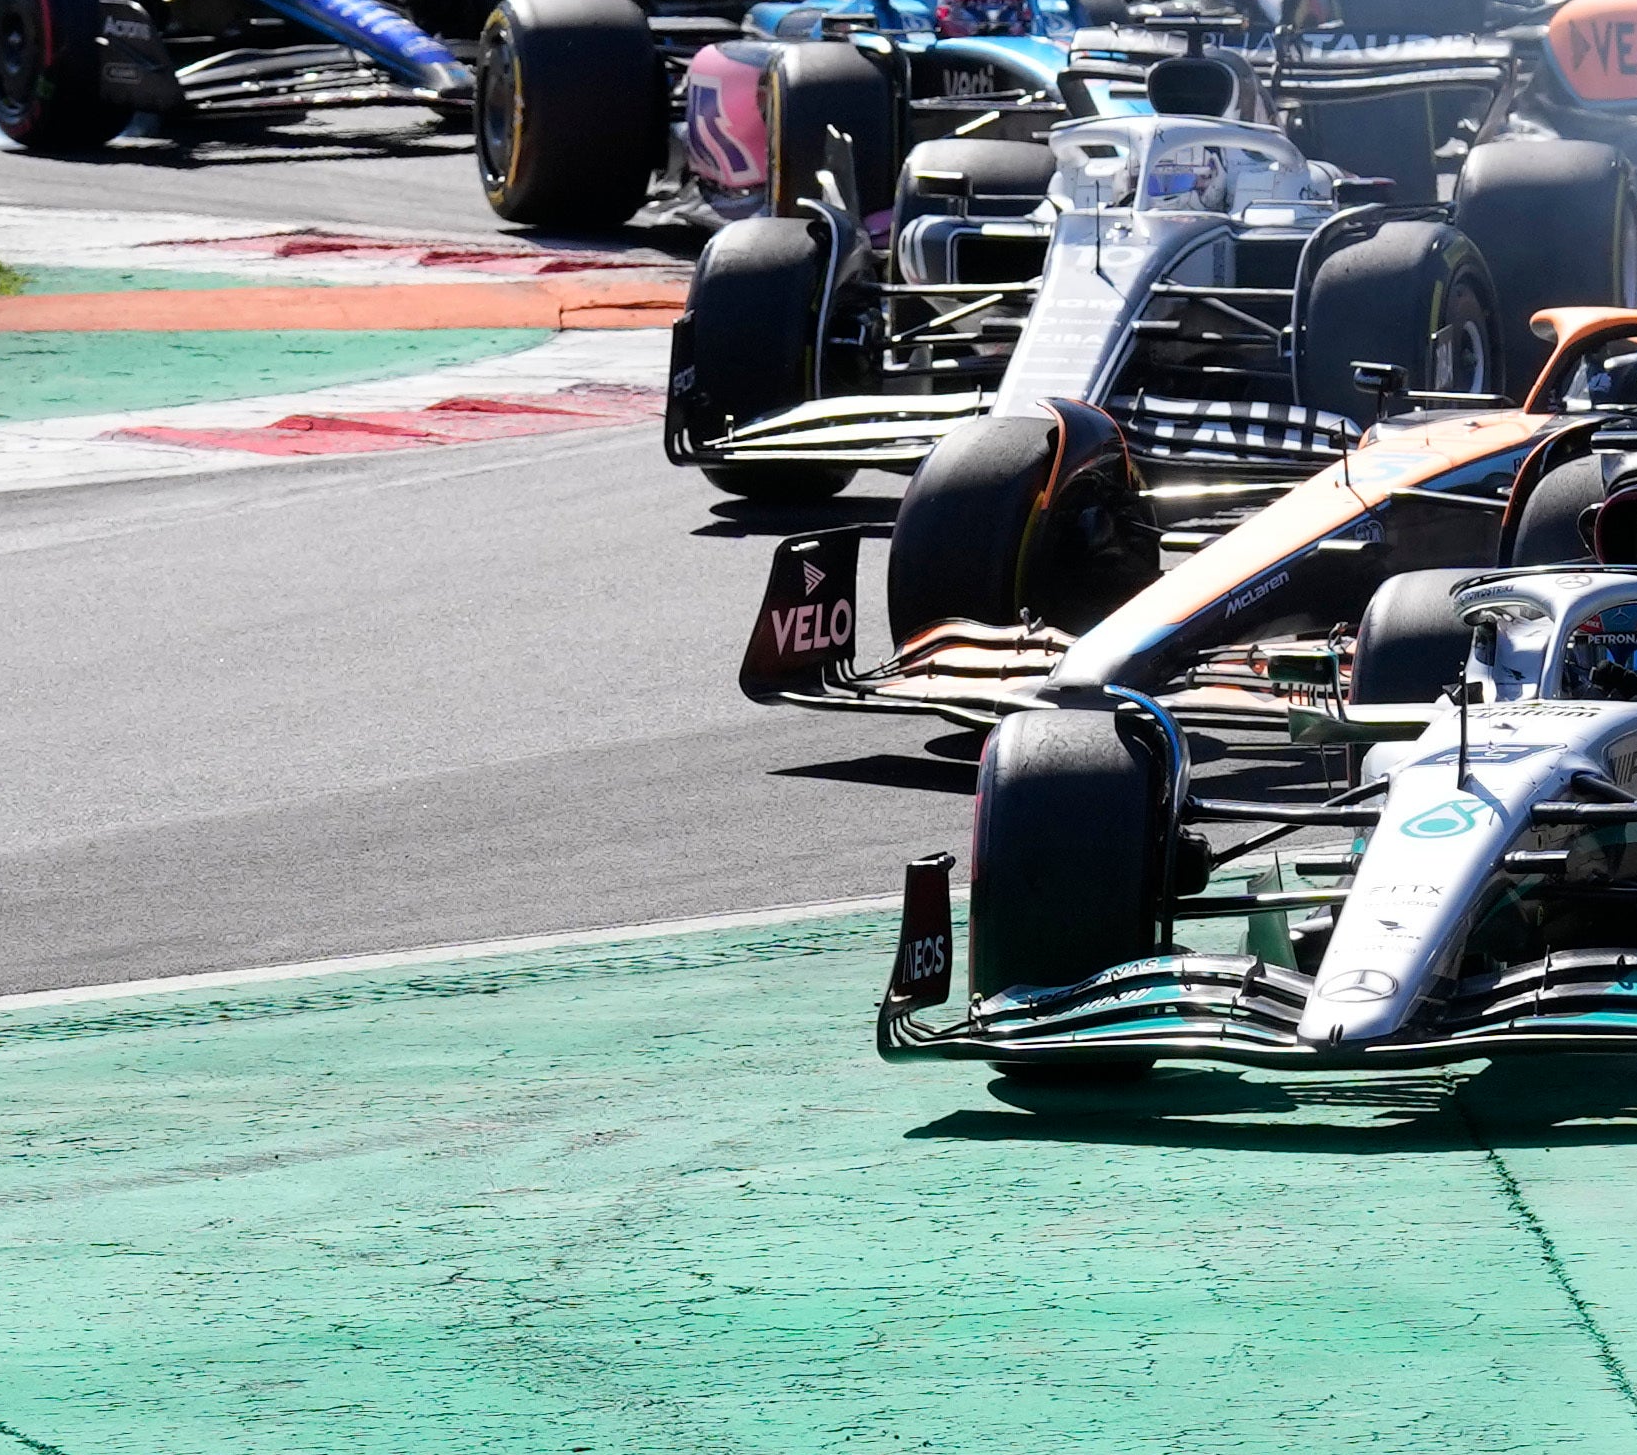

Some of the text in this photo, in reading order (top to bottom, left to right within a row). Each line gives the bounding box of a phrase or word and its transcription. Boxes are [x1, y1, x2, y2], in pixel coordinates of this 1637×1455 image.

[1225, 569, 1291, 619] McLaren
[770, 597, 853, 657] VELO
[903, 934, 945, 984] INEOS
